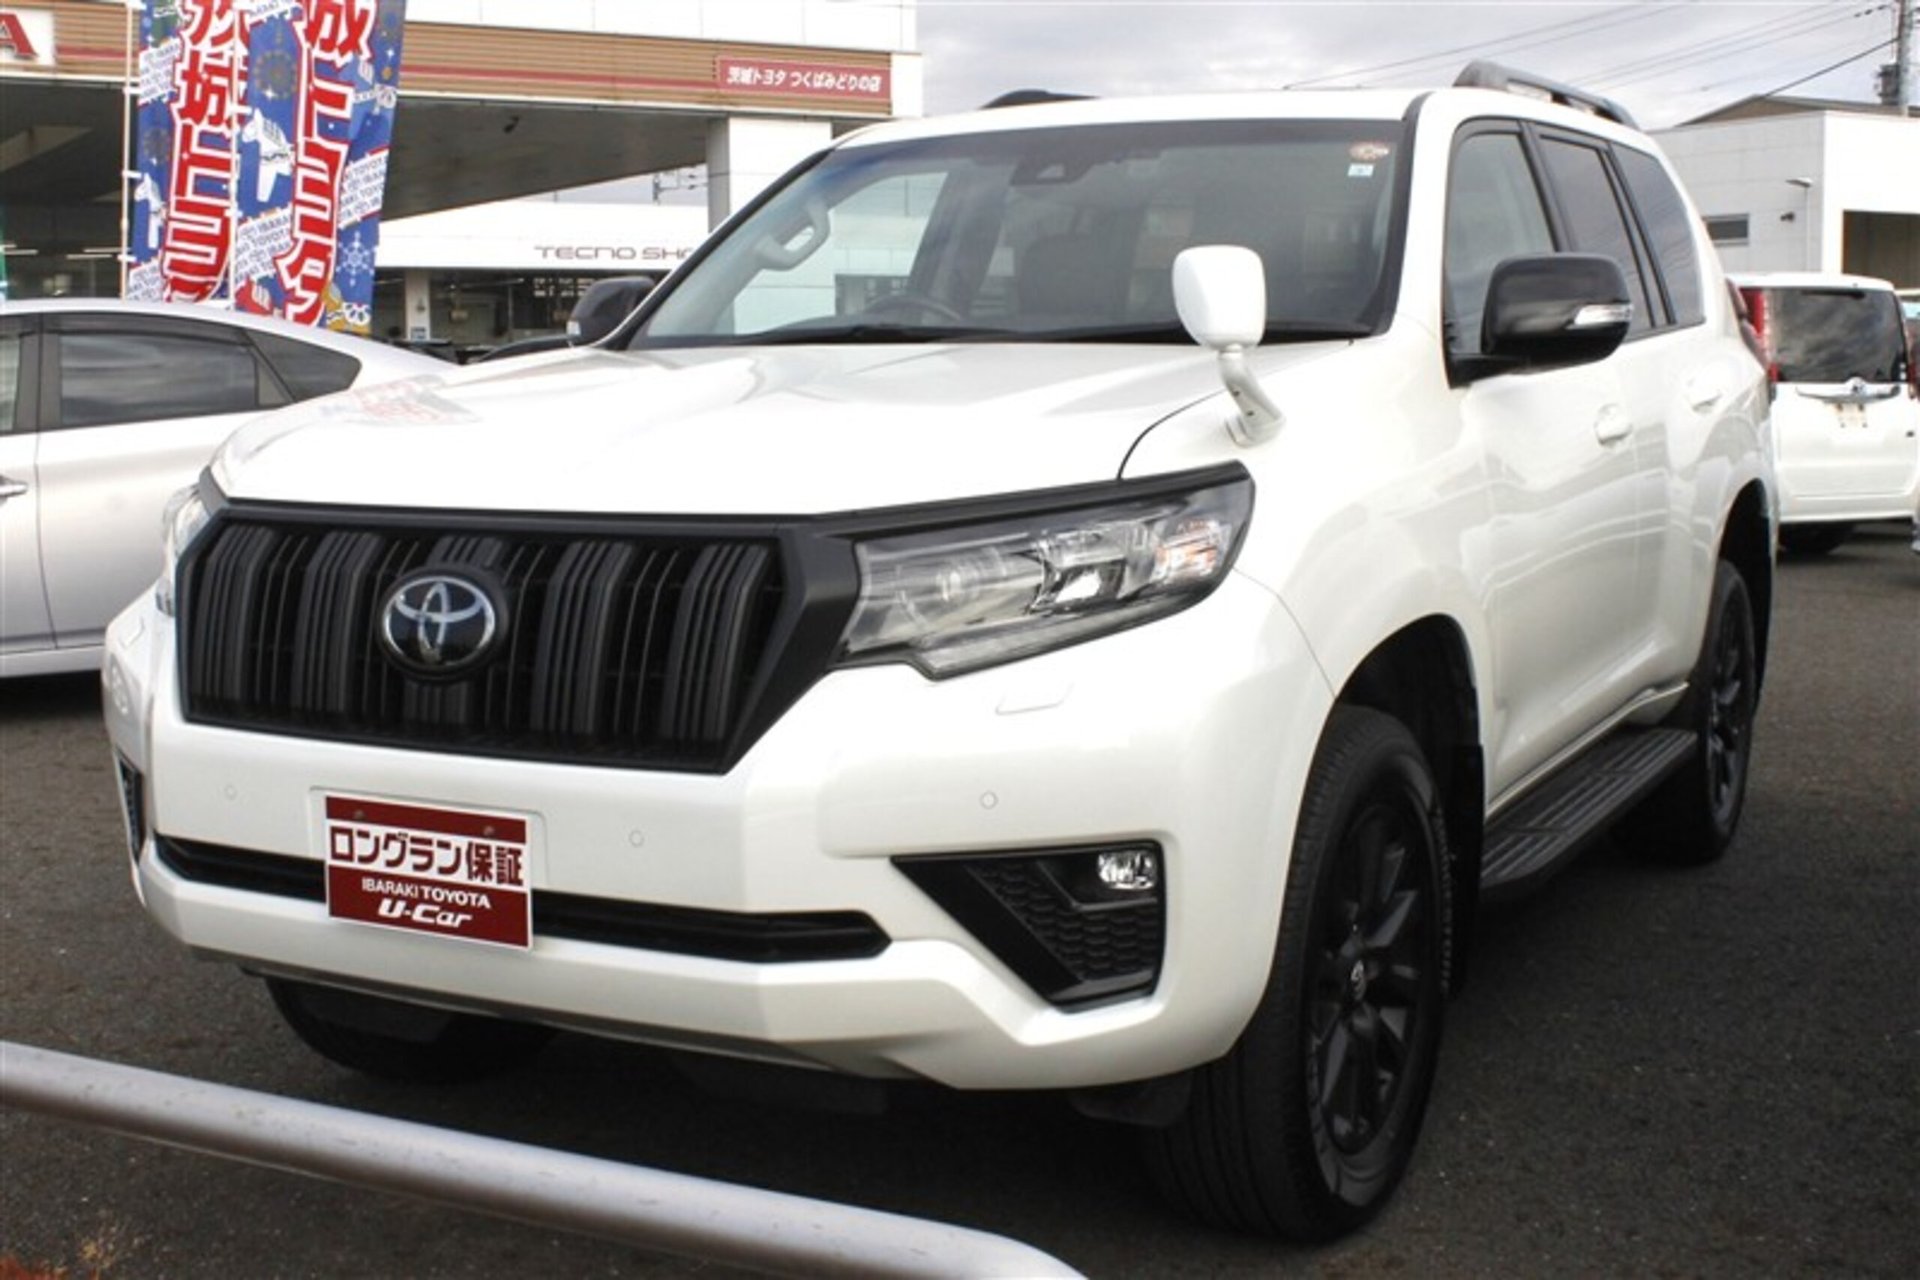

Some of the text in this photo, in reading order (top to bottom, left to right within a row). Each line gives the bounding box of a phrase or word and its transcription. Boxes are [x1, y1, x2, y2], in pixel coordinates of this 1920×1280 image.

[534, 245, 637, 260] TECNO
[330, 825, 523, 887] ロングラン保証
[362, 877, 492, 910] IBARAKI TOYOTA
[378, 898, 473, 928] U-Car
